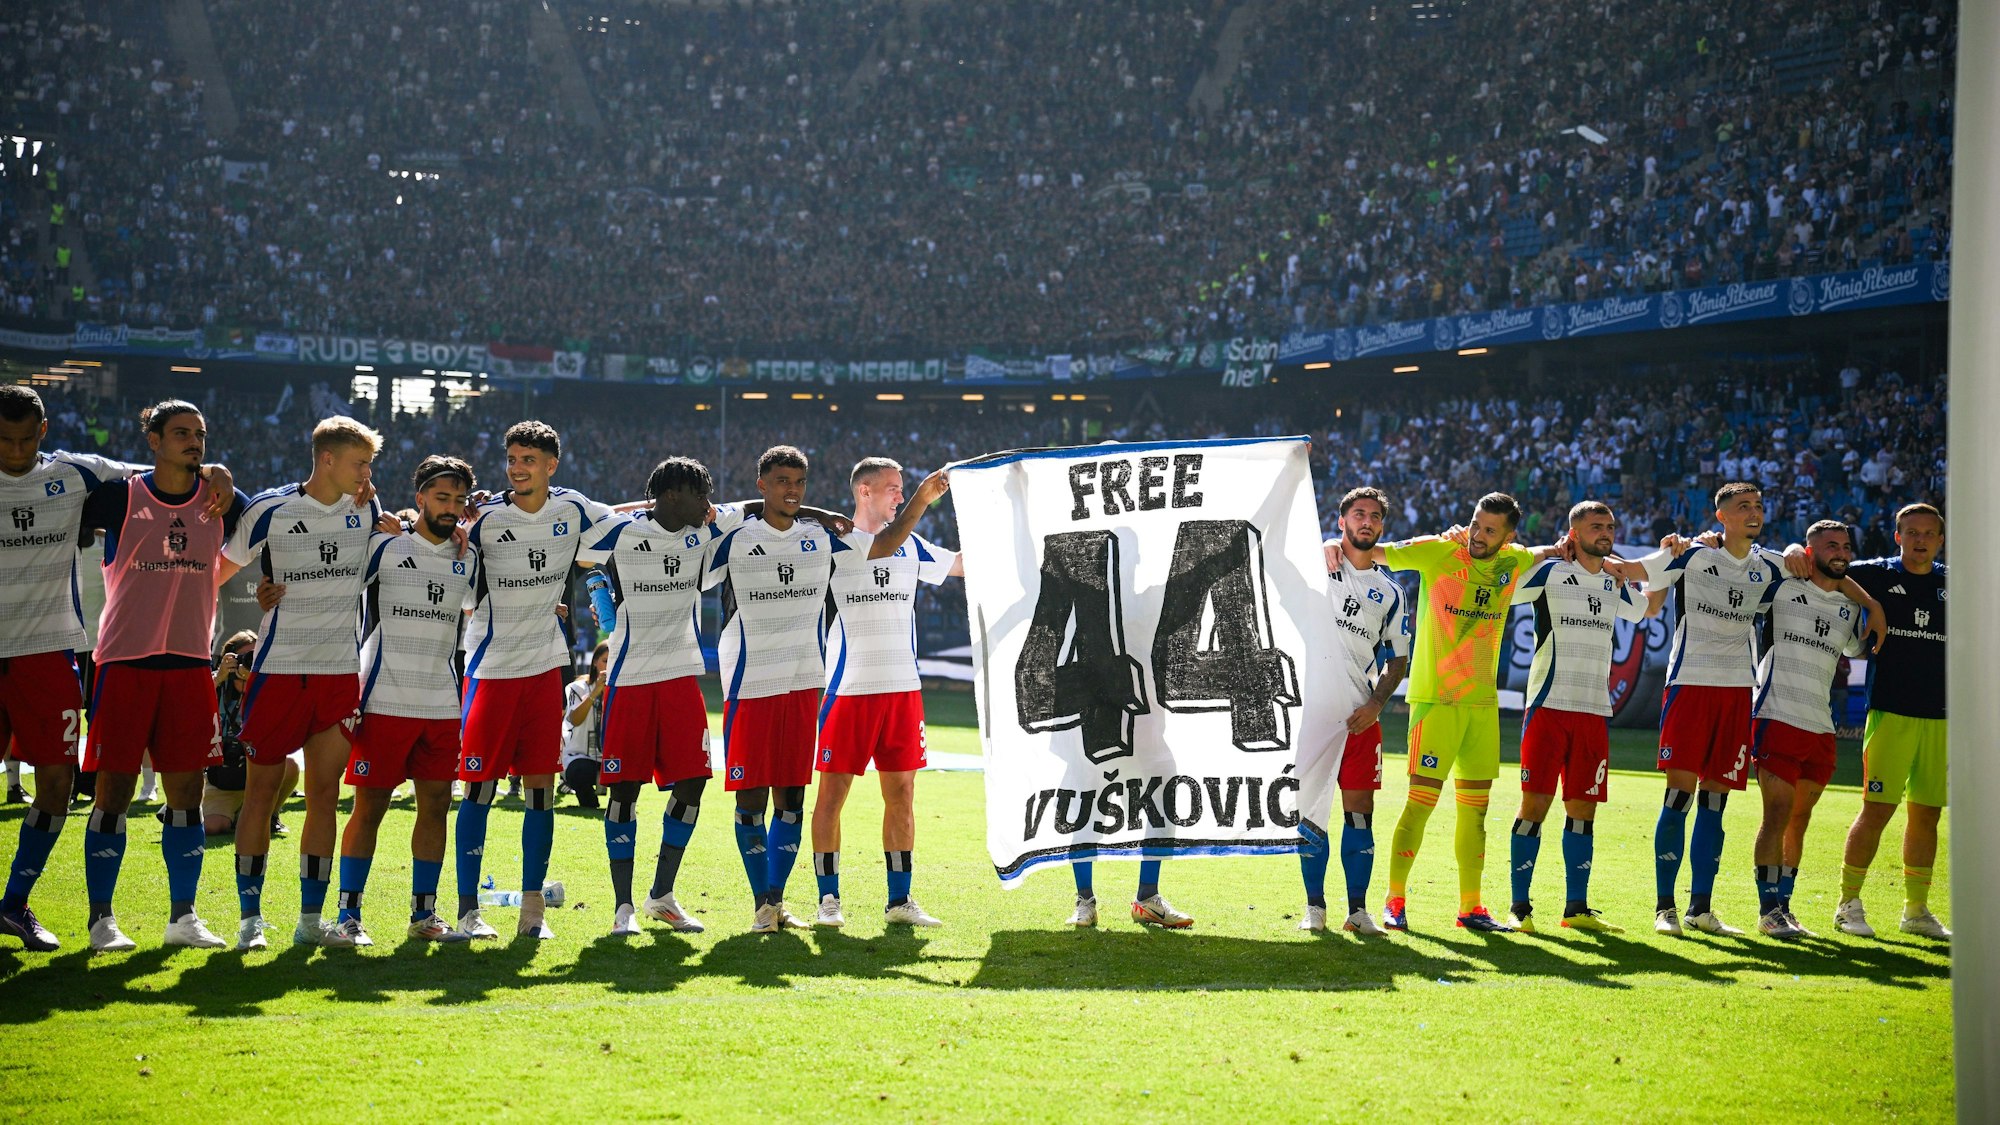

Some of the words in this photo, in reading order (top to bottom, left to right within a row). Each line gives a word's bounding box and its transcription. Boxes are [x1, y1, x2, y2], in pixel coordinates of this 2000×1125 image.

[299, 336, 378, 362] RUDE
[411, 342, 486, 371] BOYS
[1229, 338, 1278, 361] Schön
[756, 360, 815, 382] FEDE
[1068, 454, 1203, 521] FREE
[0, 532, 66, 548] nseMerkur
[498, 571, 565, 588] HanseMerkur
[633, 579, 697, 593] HanseMerkur
[749, 586, 818, 601] HanseMerkur
[846, 592, 909, 604] HanseMerkur
[1015, 520, 1302, 764] 44
[62, 709, 80, 741] 2
[1734, 744, 1747, 770] 5
[1595, 759, 1607, 784] 6
[1023, 764, 1300, 841] VUŠKOVIĆ
